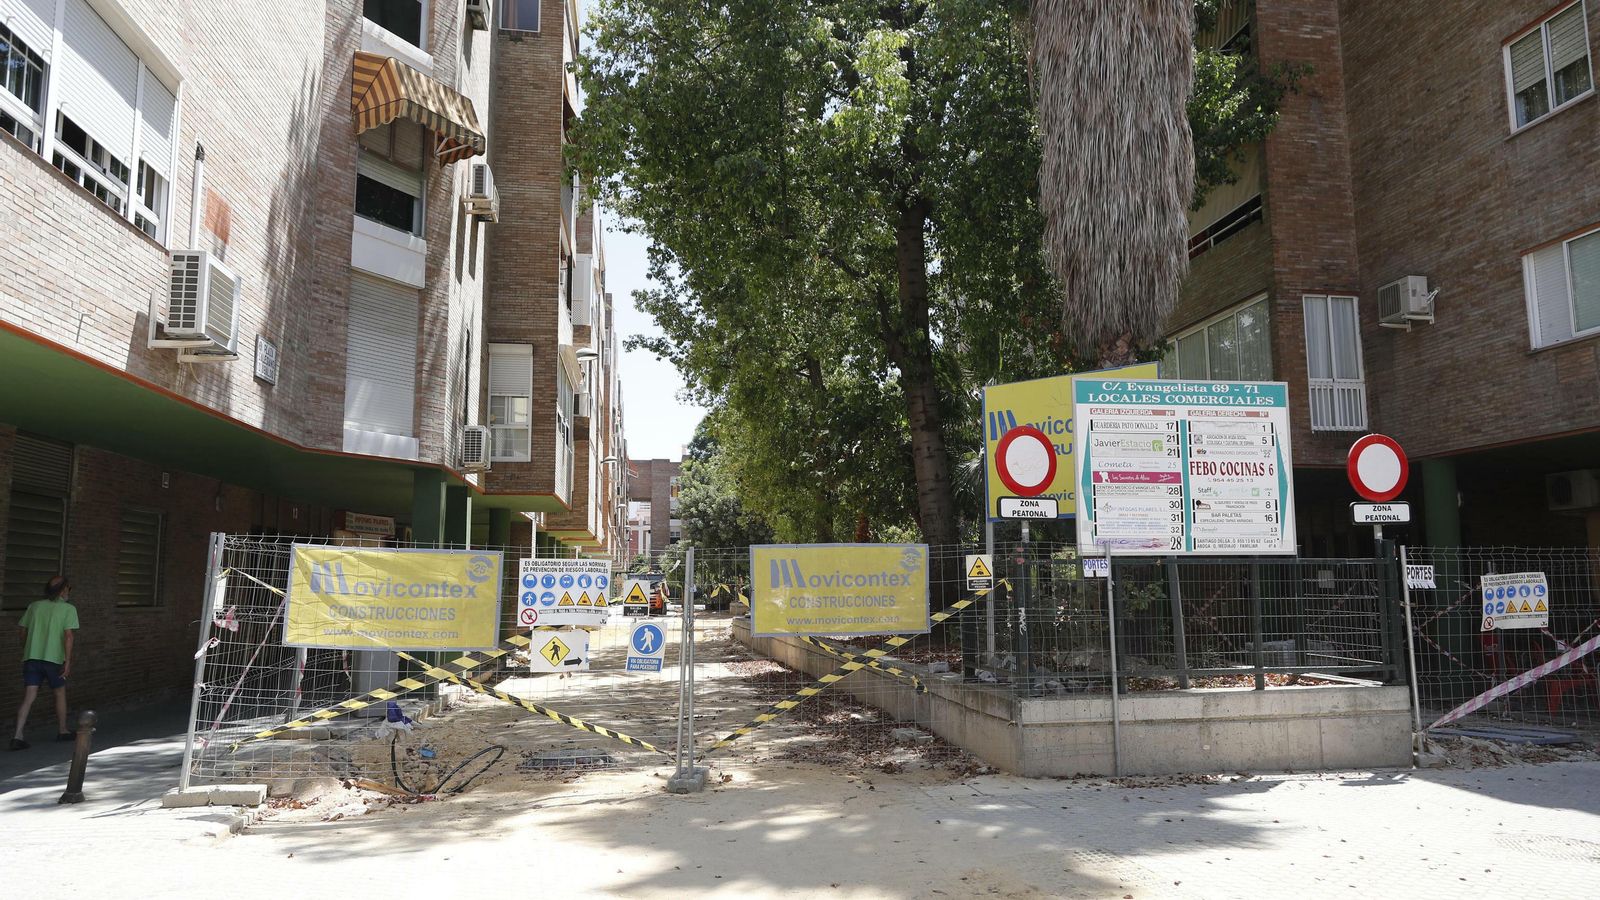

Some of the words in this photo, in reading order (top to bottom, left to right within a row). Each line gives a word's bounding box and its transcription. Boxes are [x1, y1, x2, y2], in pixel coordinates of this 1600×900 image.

[1102, 382, 1122, 391] C/.
[1127, 382, 1208, 393] Evangelista
[1212, 384, 1230, 393] 69
[1244, 385, 1260, 394] 71
[1088, 393, 1160, 403] LOCALES
[1165, 395, 1274, 405] COMERCIALES
[1190, 461, 1216, 476] FEBO
[1220, 462, 1265, 476] COCINAS
[1268, 464, 1274, 476] 6
[1170, 537, 1182, 550] 28
[1084, 560, 1108, 569] PORTES
[310, 561, 479, 598] Movicontex
[770, 559, 911, 588] Movicontex
[1406, 566, 1432, 580] PORTES
[789, 595, 896, 609] CONSTRUCCIONES
[328, 604, 456, 621] CONSTRUCCIONES
[787, 615, 900, 625] www.movicontex.com
[324, 628, 459, 639] www.movicontex.com
